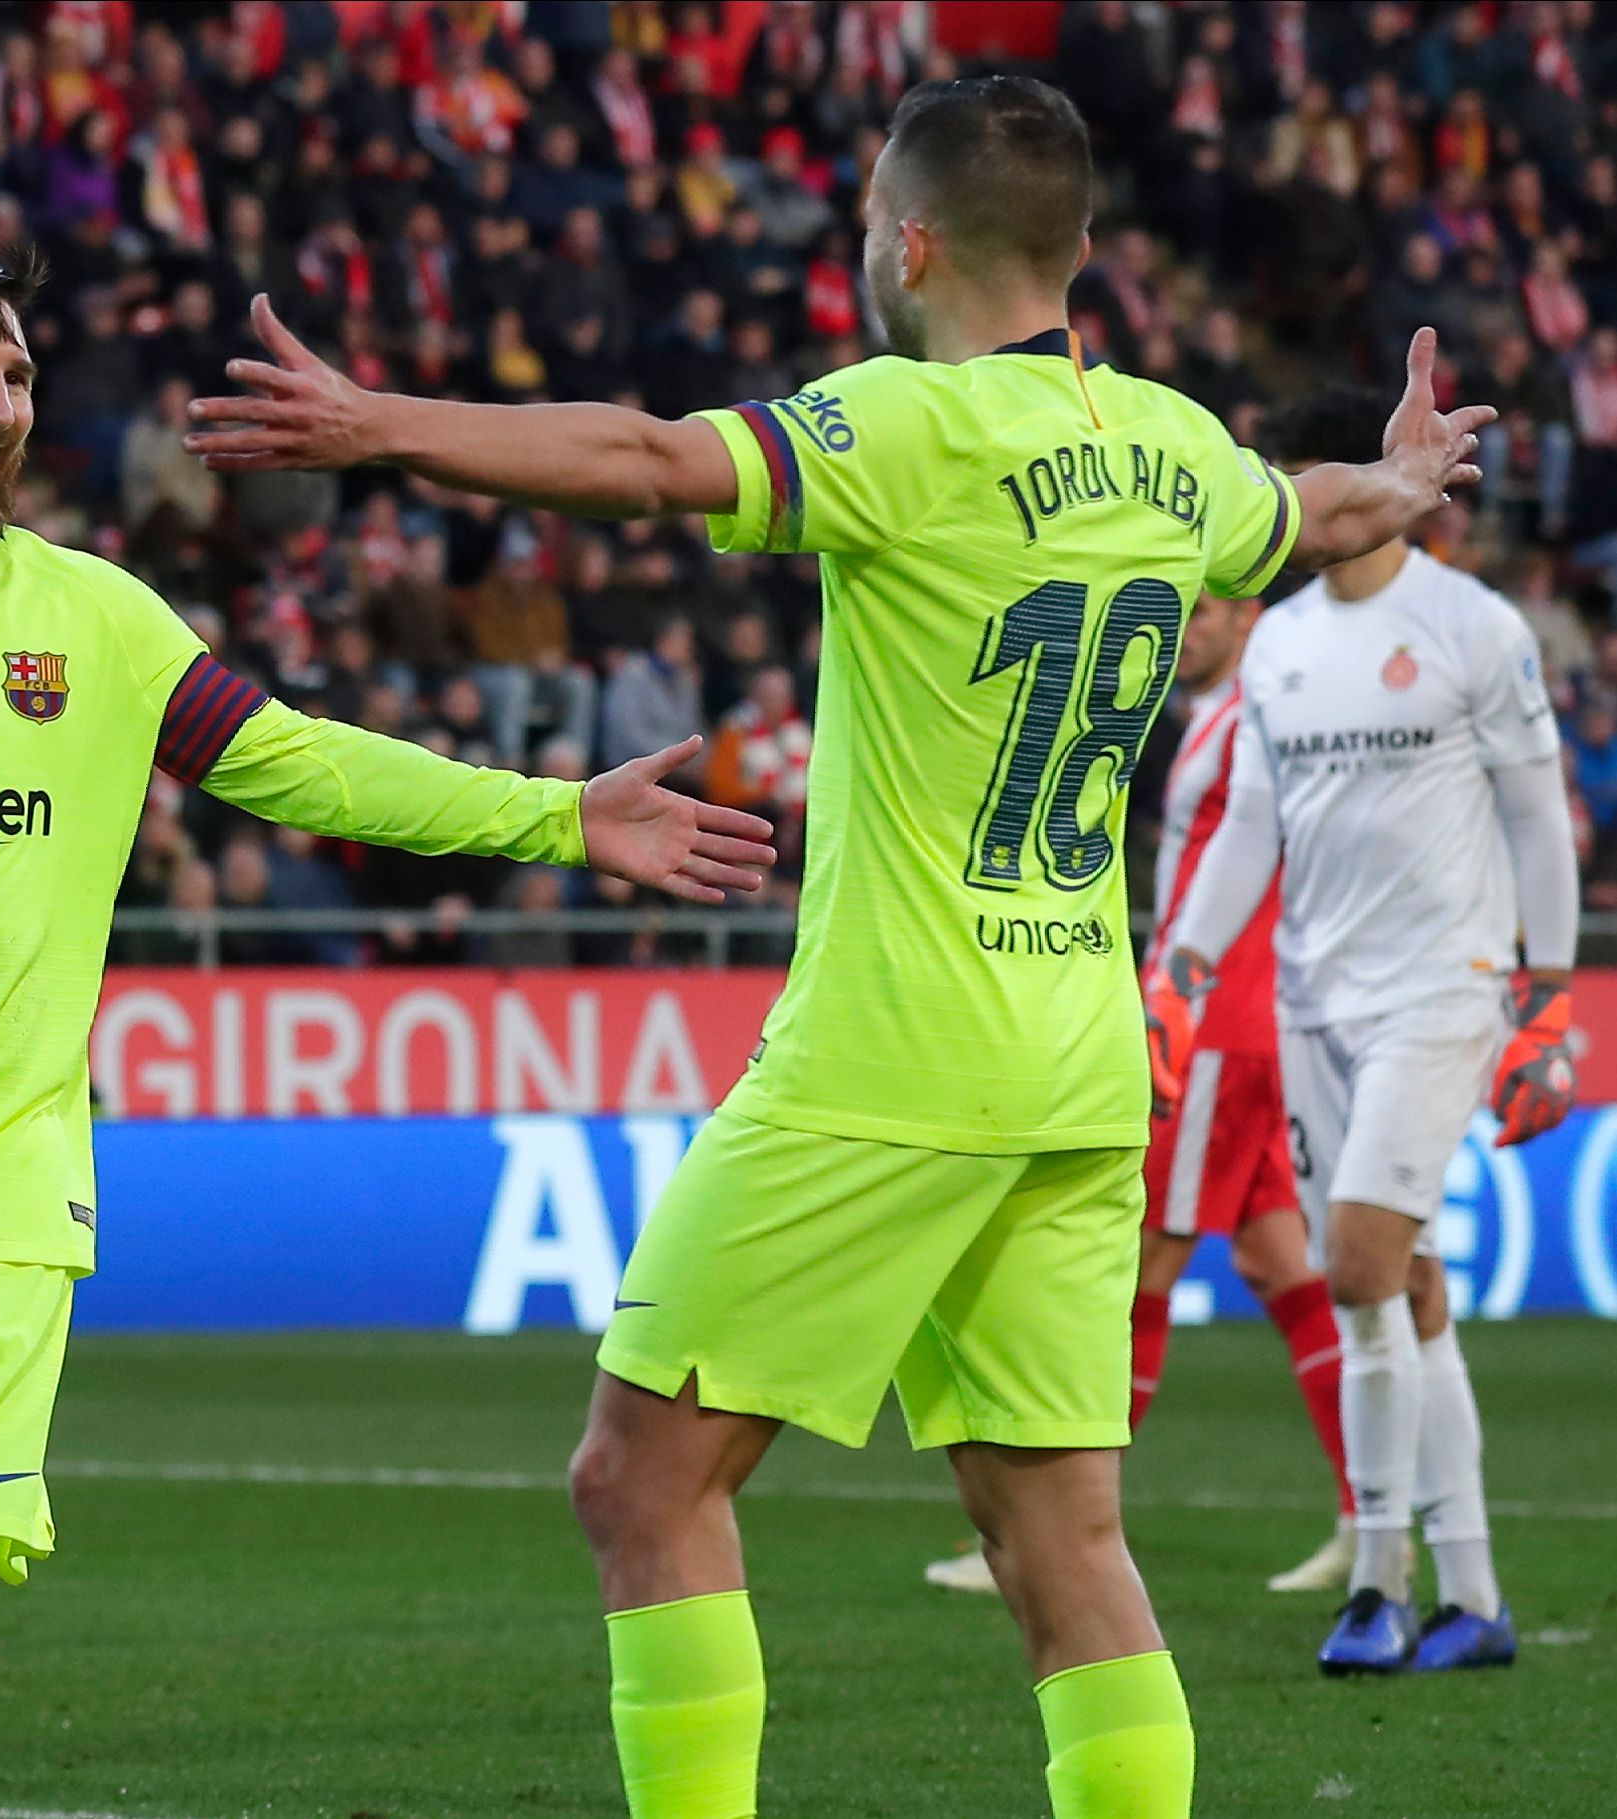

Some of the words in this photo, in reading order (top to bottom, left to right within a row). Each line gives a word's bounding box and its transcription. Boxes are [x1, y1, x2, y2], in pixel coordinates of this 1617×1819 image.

[997, 443, 1124, 548] JORDI
[24, 681, 51, 691] FCB
[964, 578, 1183, 892] 18
[1276, 728, 1434, 757] MARATHON
[94, 989, 712, 1118] GIRONA
